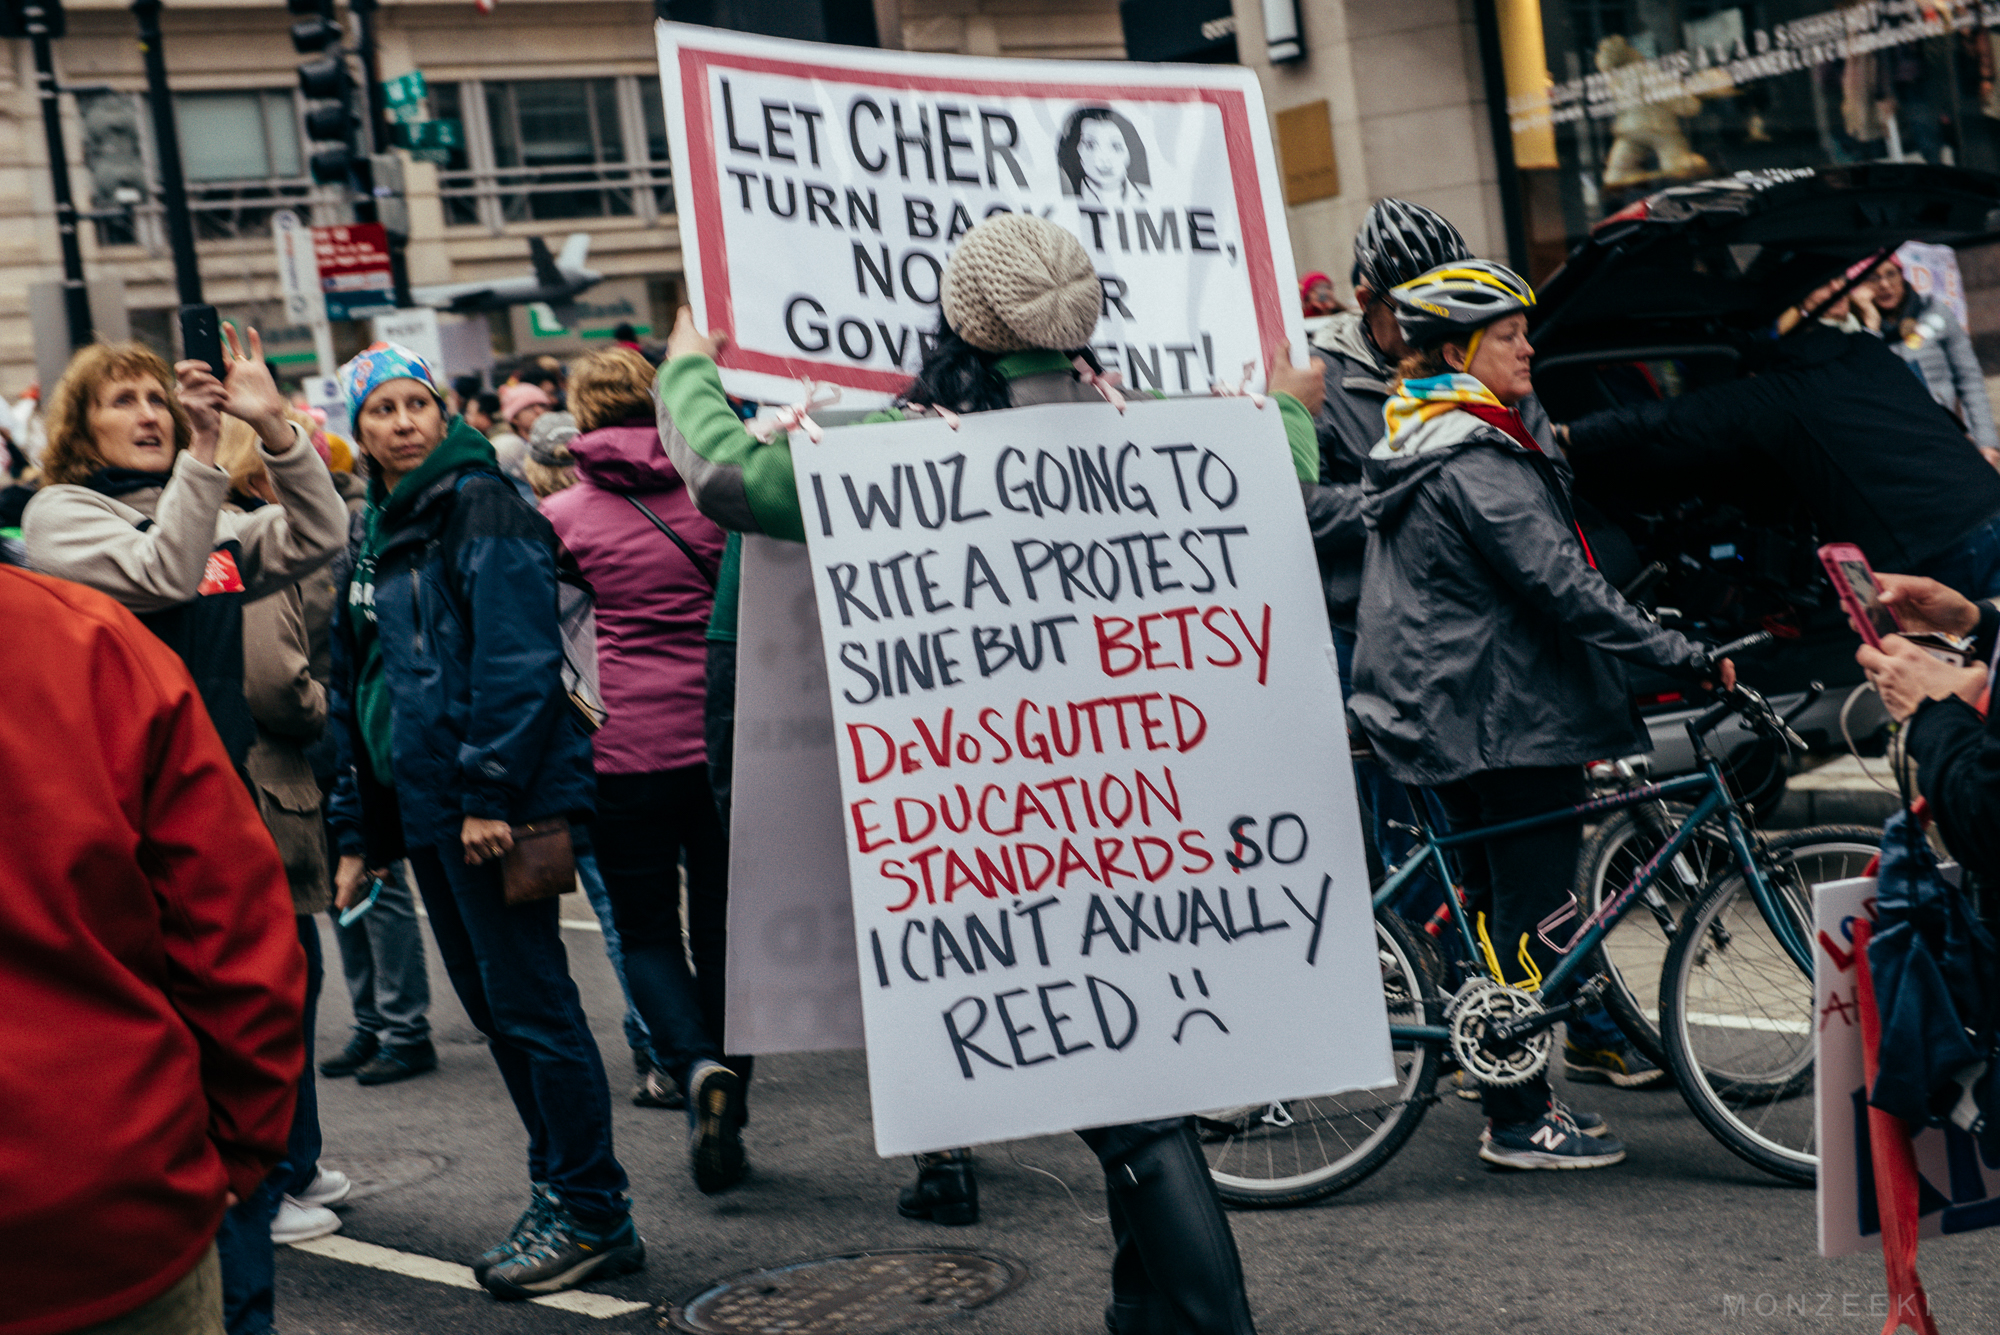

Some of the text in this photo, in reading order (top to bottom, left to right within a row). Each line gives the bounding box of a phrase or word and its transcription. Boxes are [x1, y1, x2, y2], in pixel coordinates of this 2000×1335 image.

[720, 77, 1029, 191] LET CHER
[726, 168, 1238, 267] TURN BA TIME,
[810, 440, 1239, 537] I WUZ GOING TO
[827, 526, 1248, 626] RITE A PROTEST
[840, 603, 1271, 705] SINE BUT BETSY
[1015, 692, 1208, 764] GUTTED
[851, 766, 1183, 855] EDUCATION
[880, 812, 1309, 913] STANDARDS SO
[870, 872, 1333, 988] I CAN'T AXUALLY
[941, 974, 1139, 1080] REED
